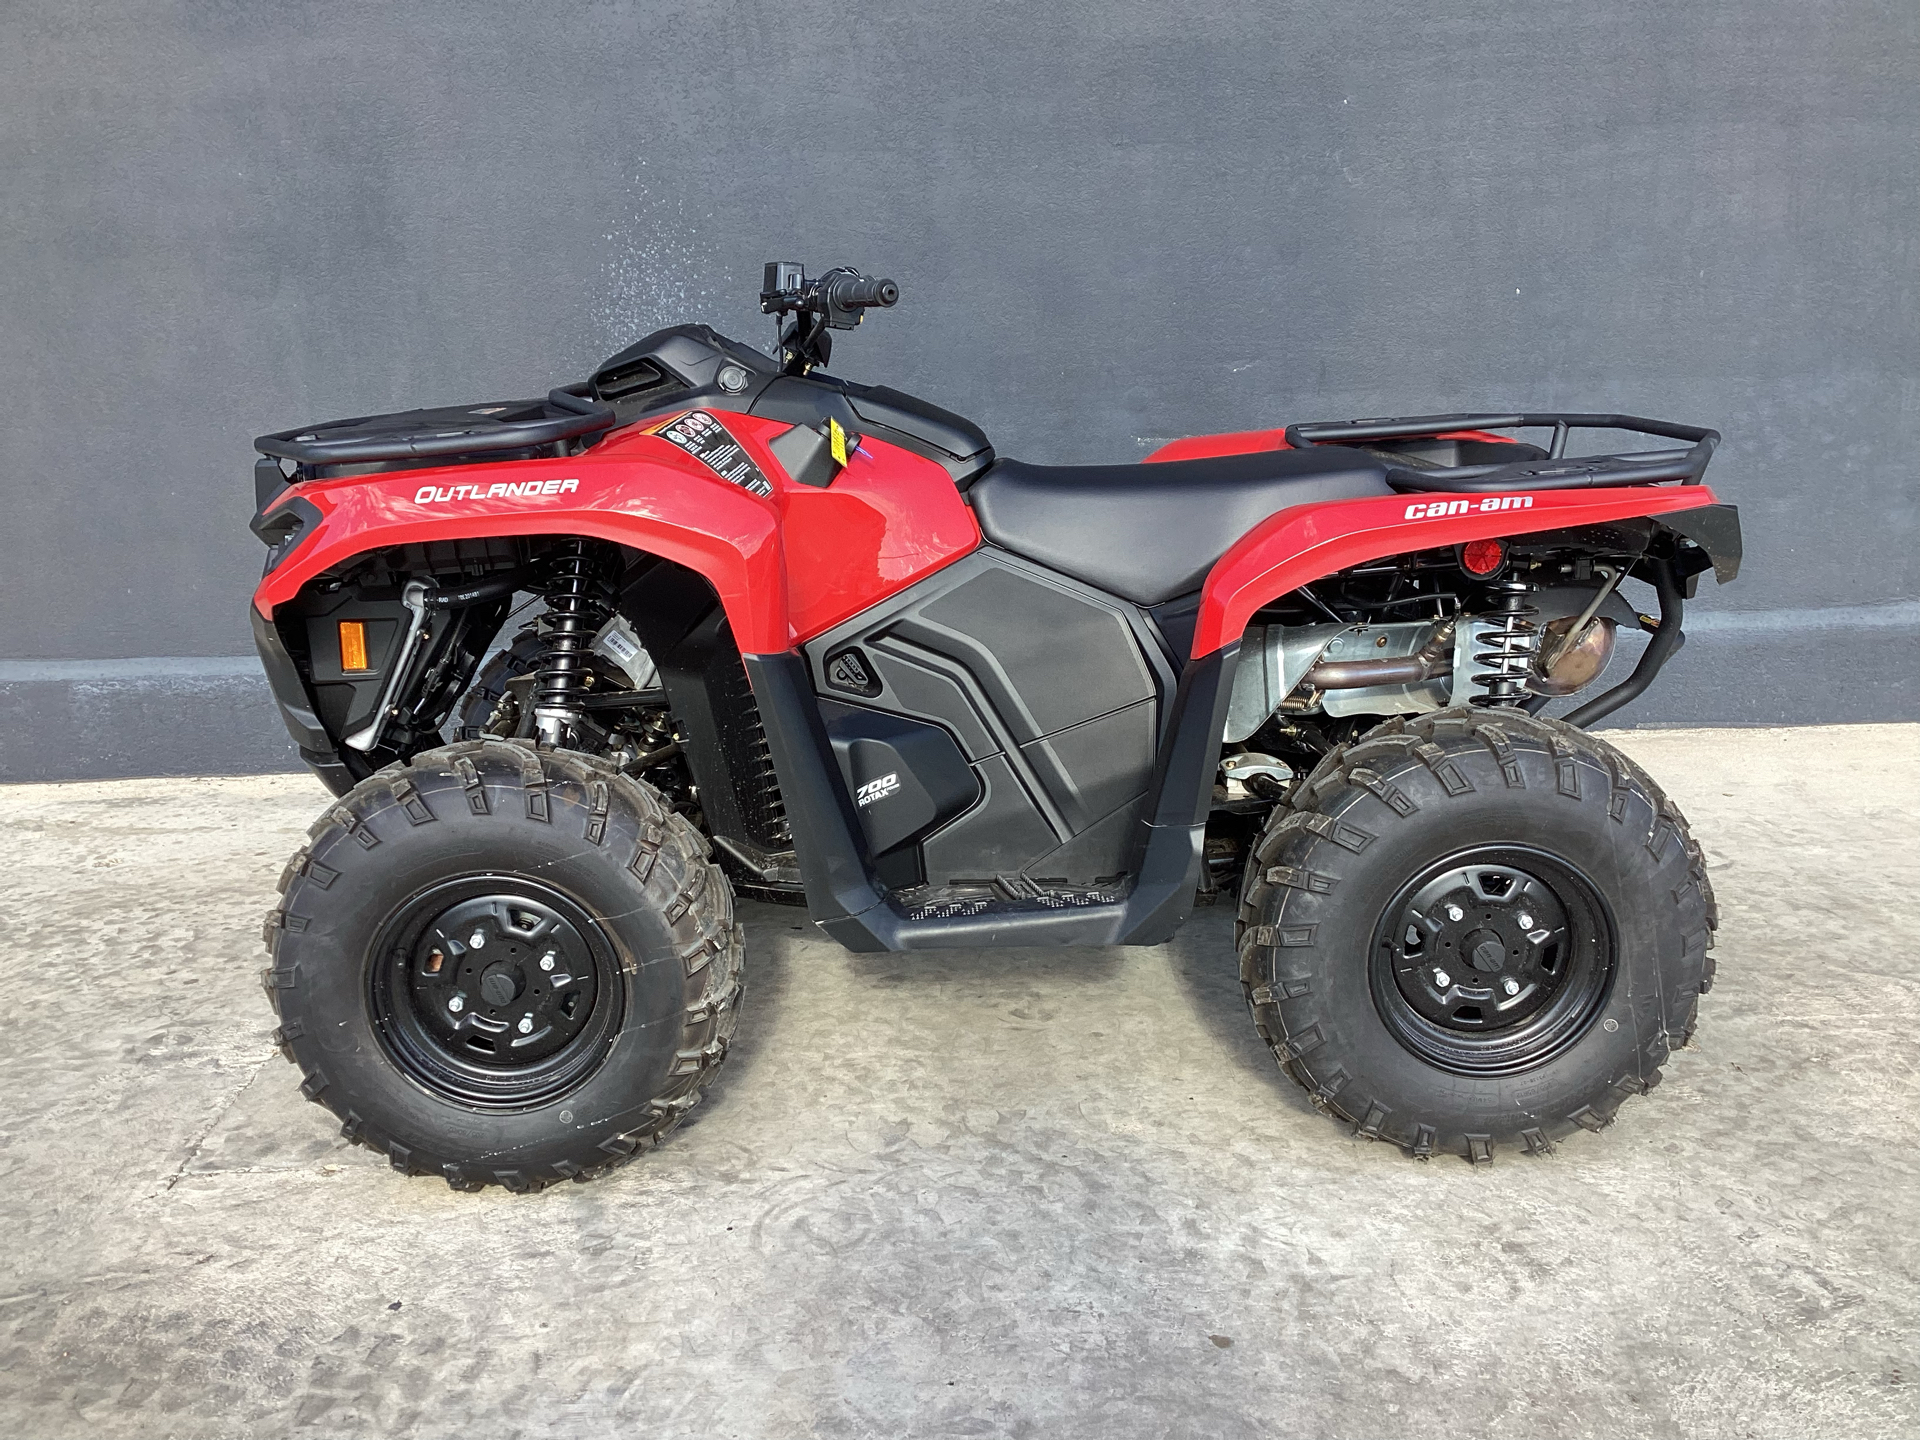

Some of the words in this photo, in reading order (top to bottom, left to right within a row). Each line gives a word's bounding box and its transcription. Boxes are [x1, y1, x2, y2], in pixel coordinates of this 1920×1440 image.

[414, 479, 580, 504] OUTLANDER
[1404, 496, 1534, 520] can-am
[856, 773, 897, 800] 700
[857, 787, 889, 807] ROTAX
